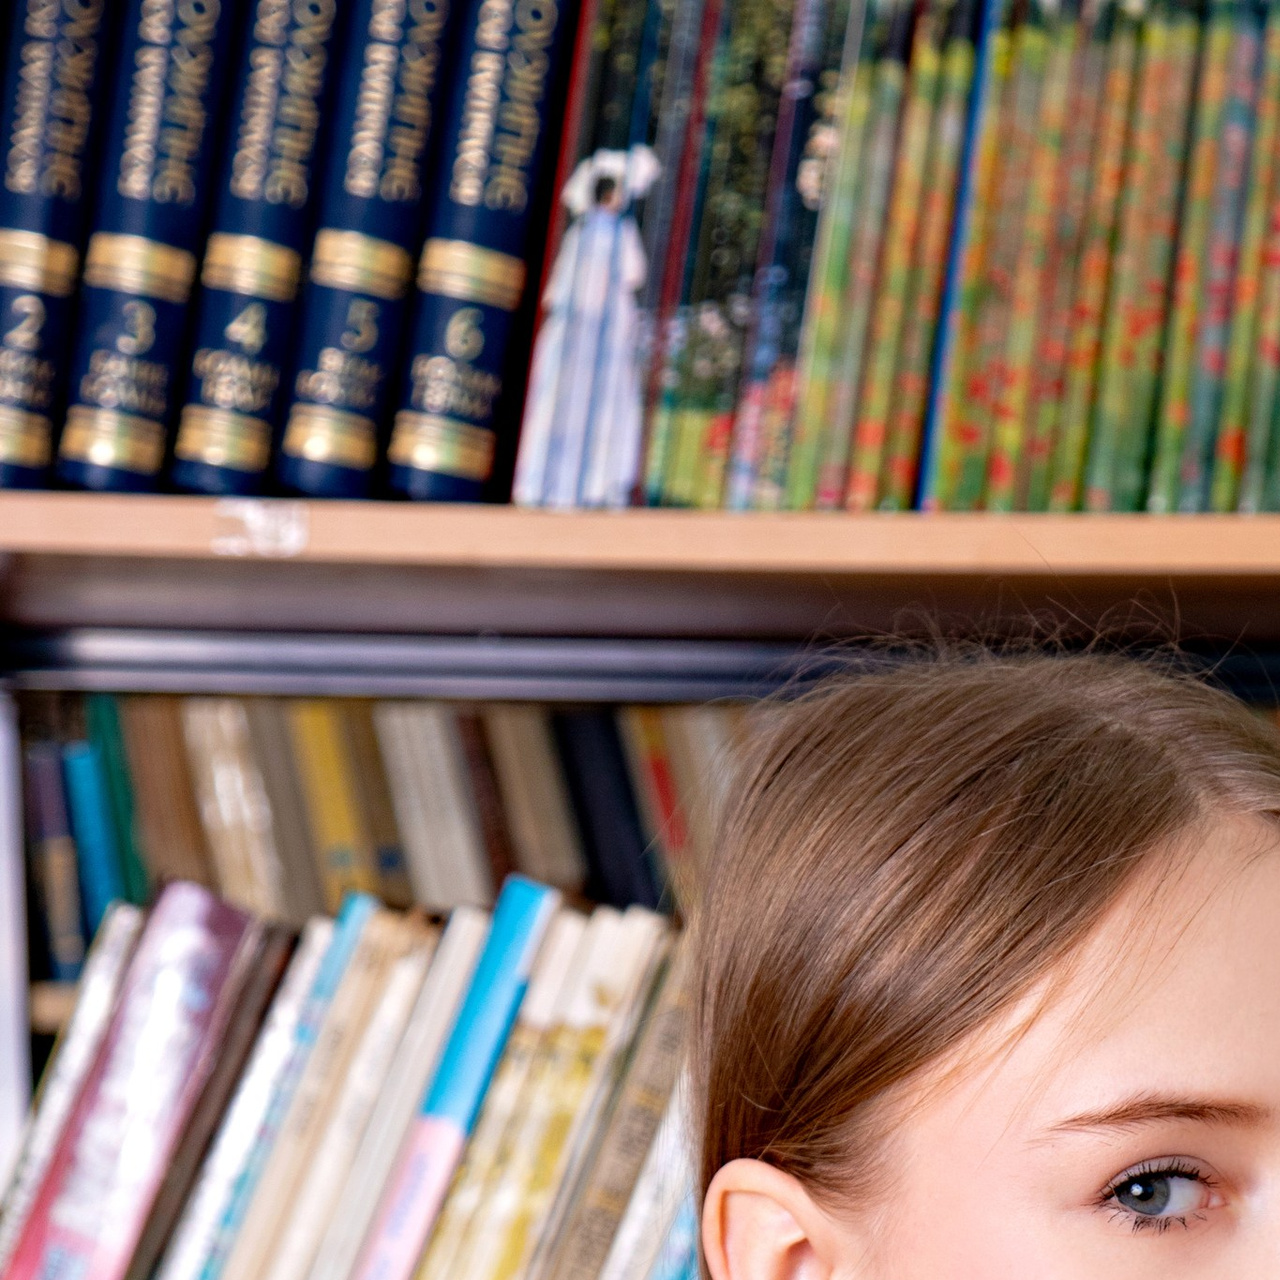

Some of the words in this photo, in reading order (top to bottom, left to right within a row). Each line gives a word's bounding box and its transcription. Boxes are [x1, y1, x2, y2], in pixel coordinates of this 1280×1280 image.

[4, 295, 45, 350] 2
[116, 299, 157, 355] 3
[225, 302, 268, 354] 4
[340, 299, 380, 353] 5
[444, 307, 485, 361] 6
